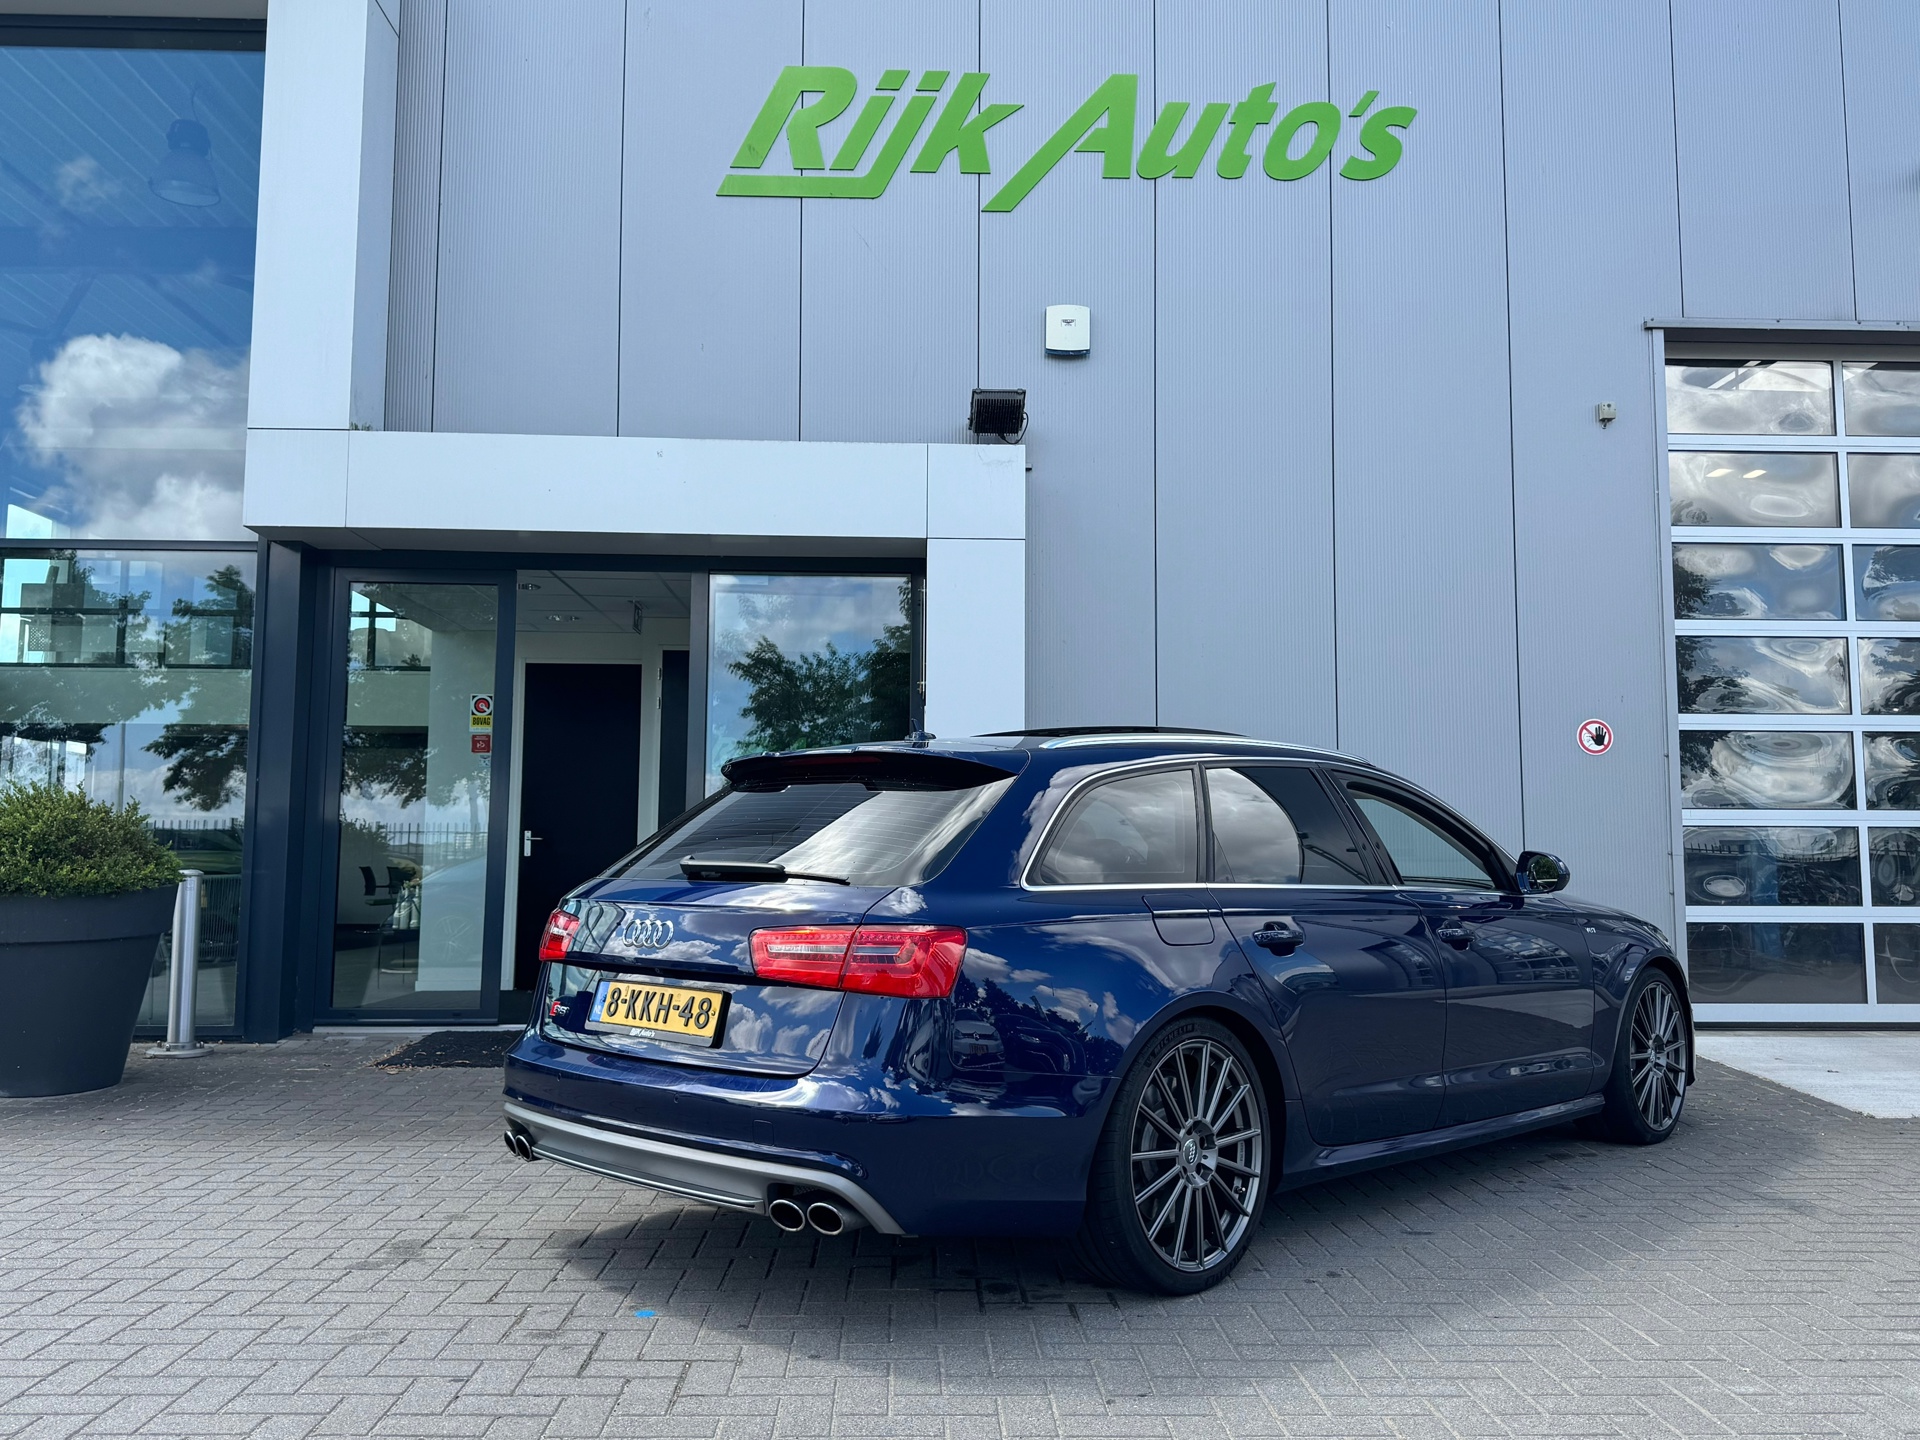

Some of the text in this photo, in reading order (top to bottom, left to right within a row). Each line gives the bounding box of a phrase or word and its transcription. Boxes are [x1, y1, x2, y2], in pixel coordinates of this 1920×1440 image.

[716, 66, 1418, 213] Rijk Auto's
[472, 717, 491, 726] BOVAG
[606, 987, 713, 1030] 8-KKH-48
[1153, 1024, 1194, 1057] MICHELIN
